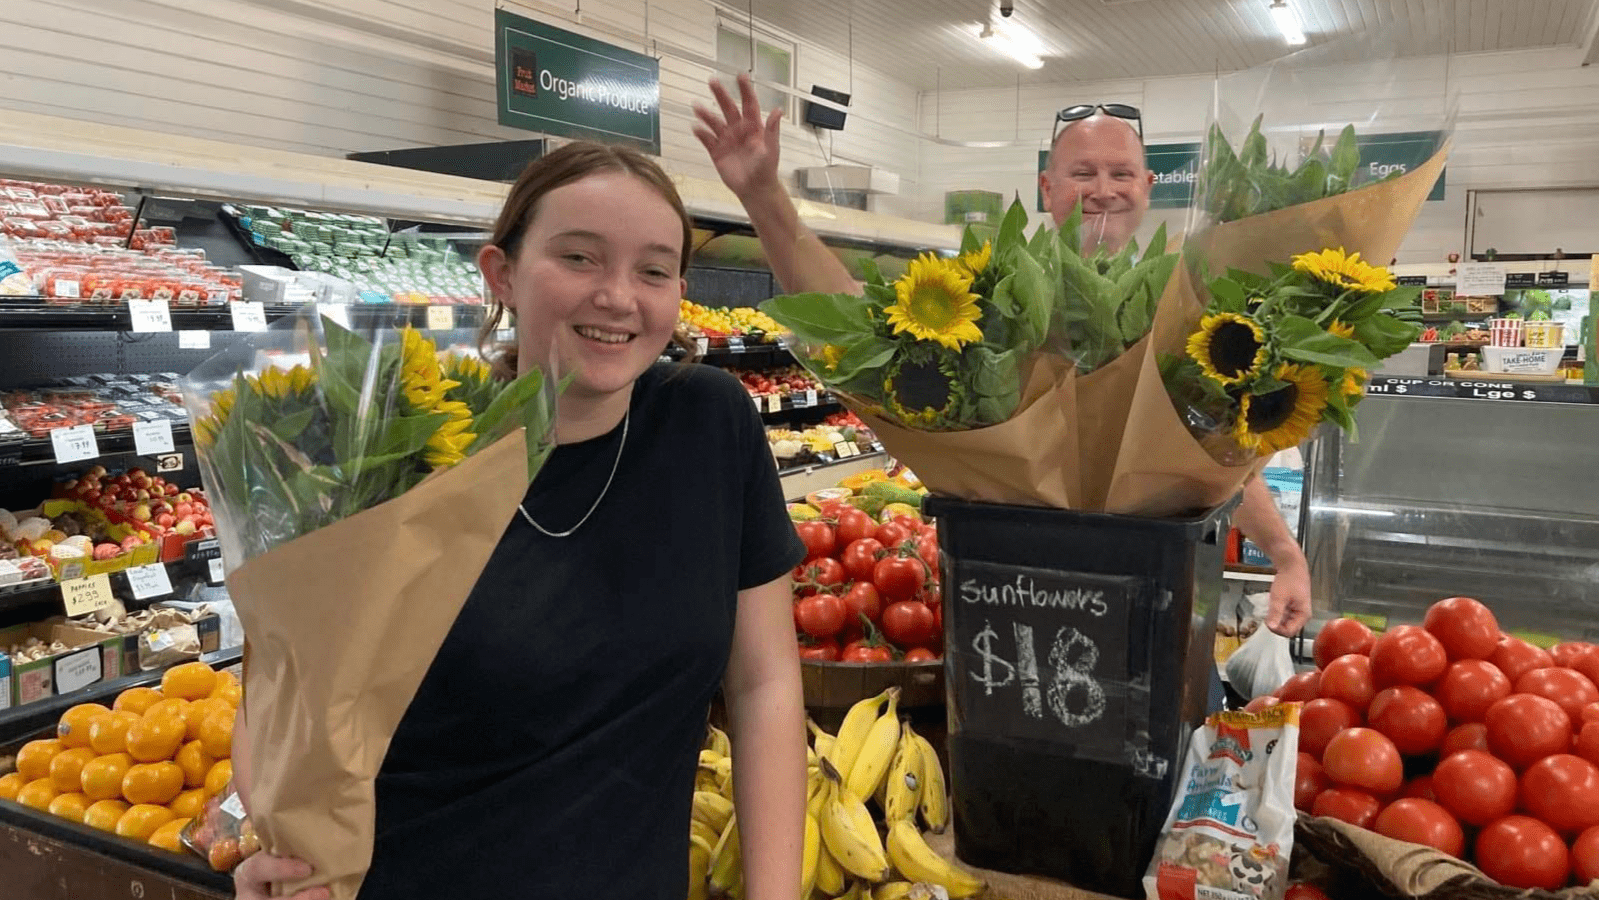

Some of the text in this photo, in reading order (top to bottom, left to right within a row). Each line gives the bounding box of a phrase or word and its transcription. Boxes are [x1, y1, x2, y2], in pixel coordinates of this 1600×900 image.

[540, 69, 649, 115] Organic Produce
[1152, 169, 1198, 184] etables
[1502, 353, 1546, 365] TAKE-HOME
[1386, 378, 1424, 386] CUP
[1368, 384, 1408, 394] ml $
[1473, 388, 1536, 400] Lge $
[969, 619, 1107, 728] $18
